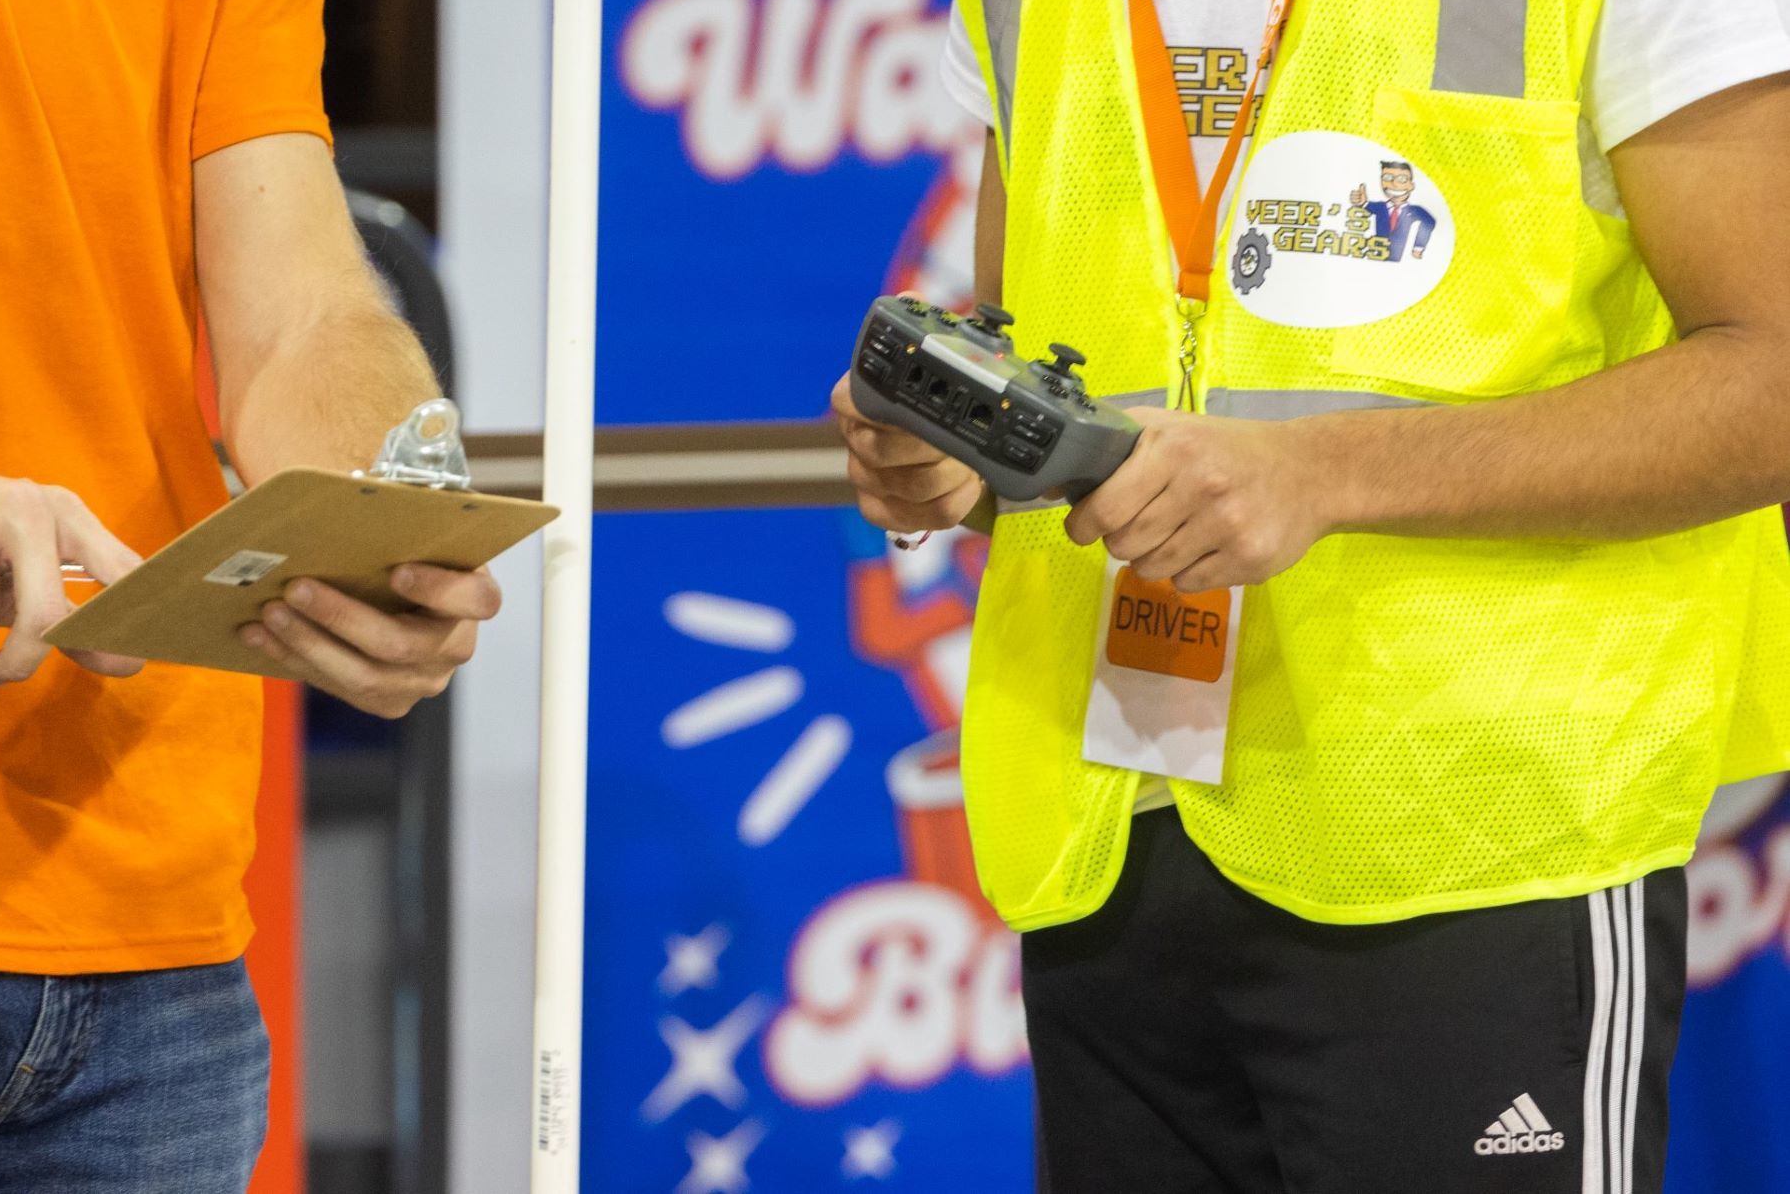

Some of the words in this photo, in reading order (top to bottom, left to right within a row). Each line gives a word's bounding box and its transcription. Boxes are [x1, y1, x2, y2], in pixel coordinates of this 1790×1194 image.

[1246, 199, 1372, 232] VEER'S
[1273, 227, 1390, 261] GEARS
[1115, 595, 1221, 647] DRIVER
[1473, 1131, 1566, 1156] adidas
